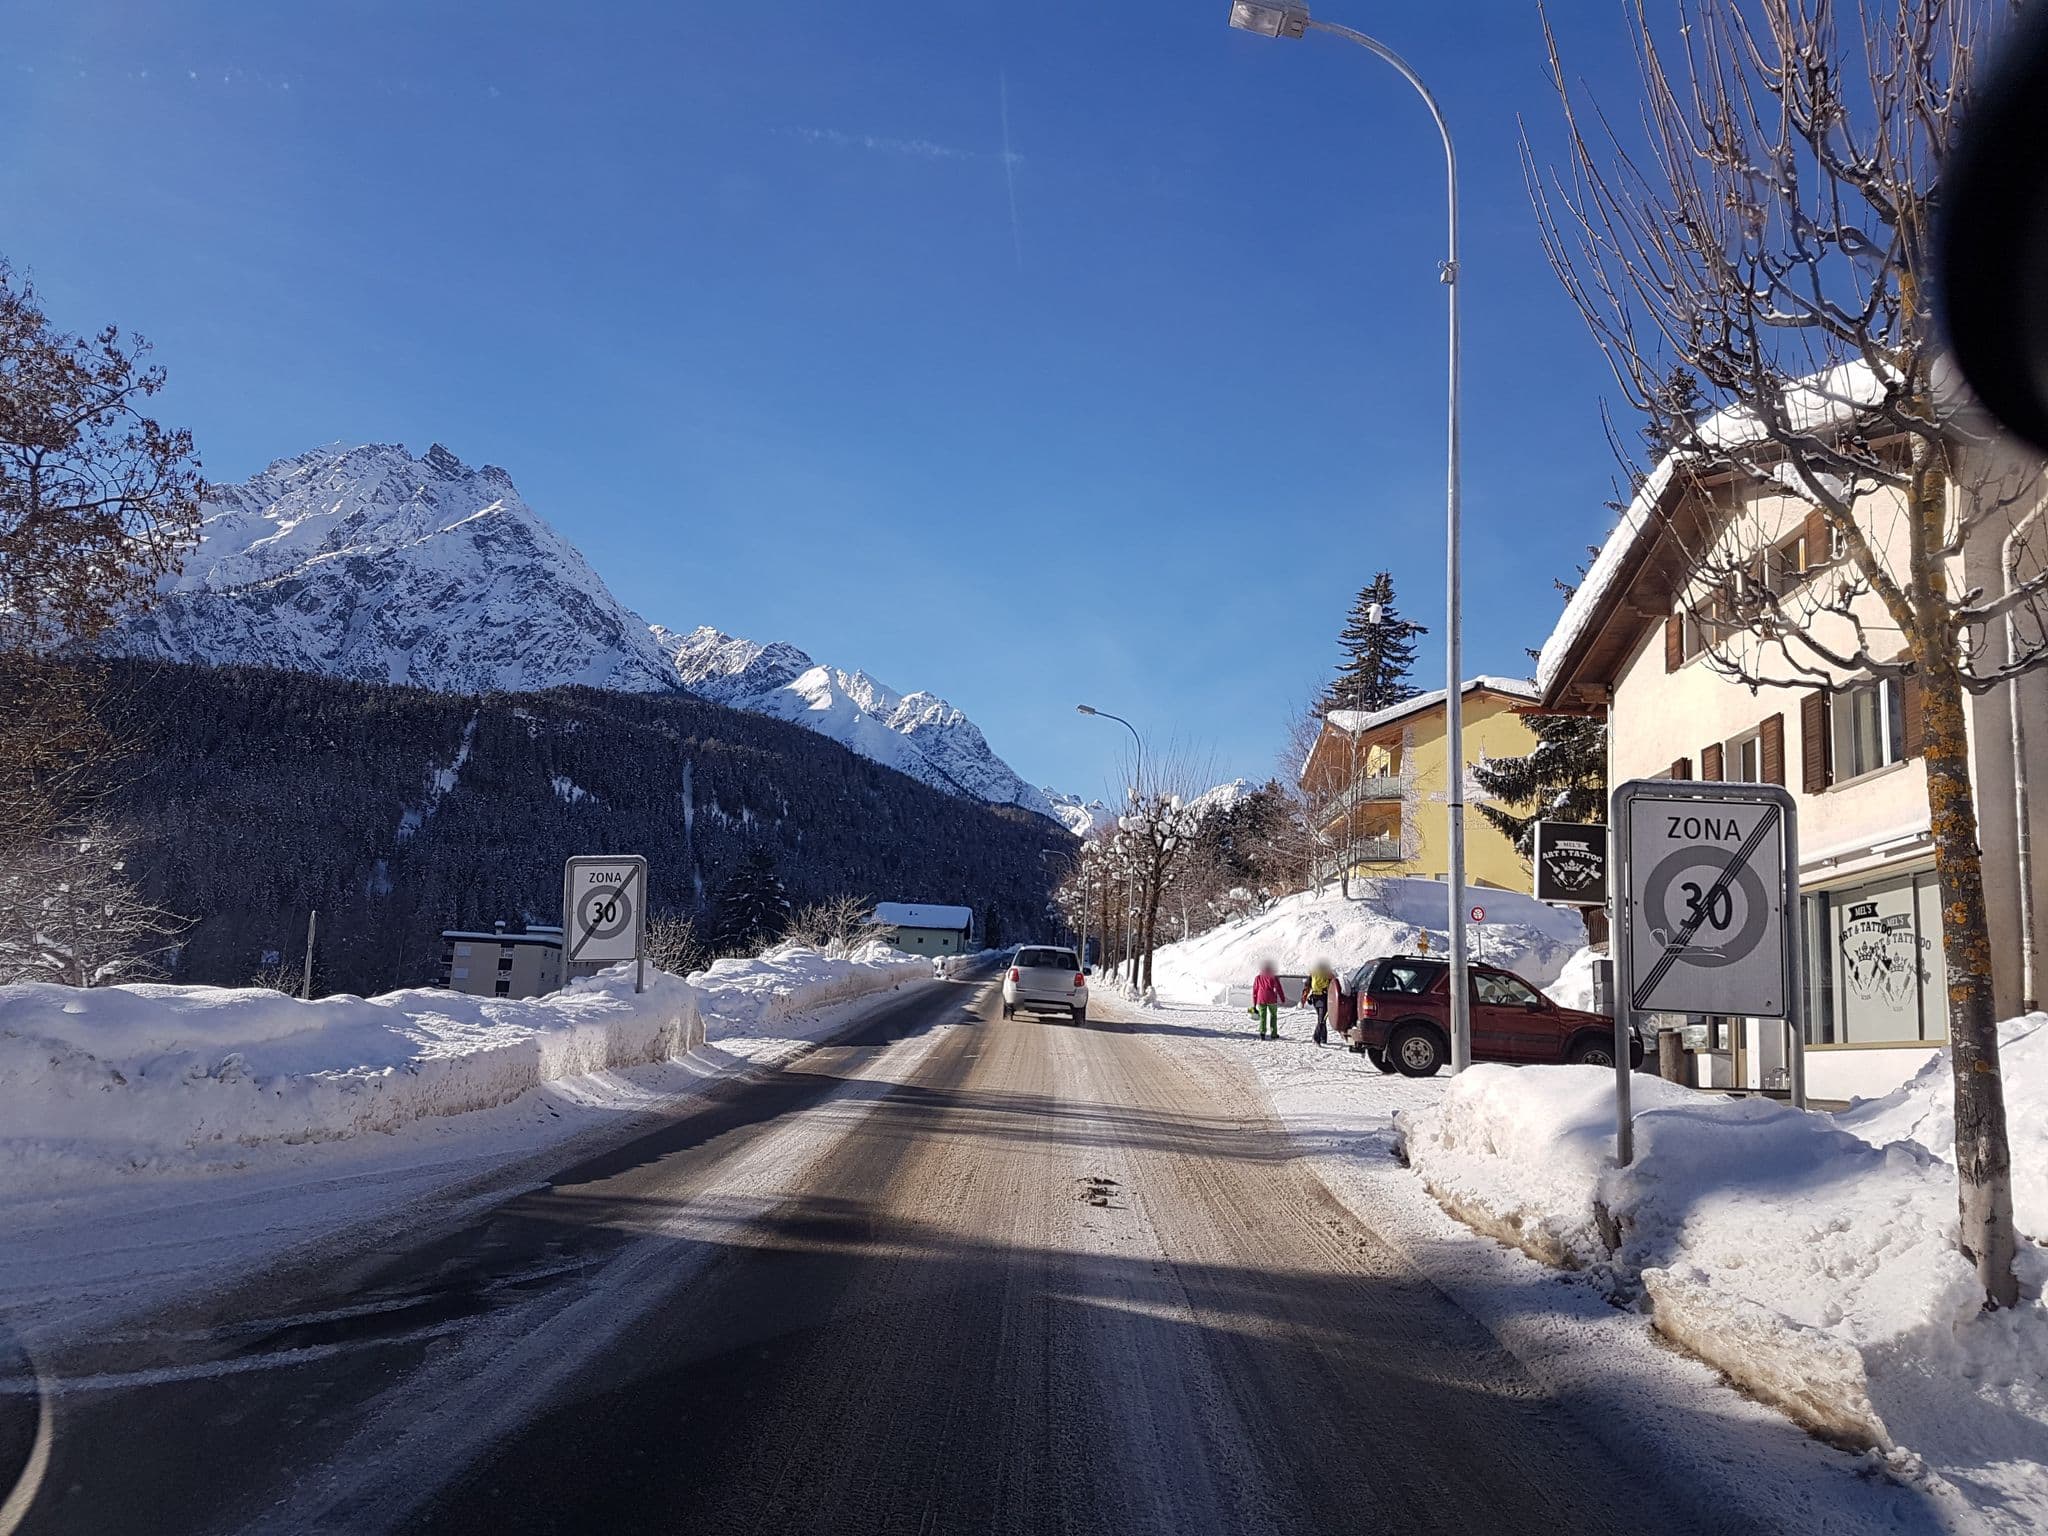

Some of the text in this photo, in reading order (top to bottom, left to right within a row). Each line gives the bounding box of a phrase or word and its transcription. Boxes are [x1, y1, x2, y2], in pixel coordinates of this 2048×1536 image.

[1667, 816, 1742, 841] ZONA
[1542, 850, 1560, 860] ART
[1568, 850, 1603, 863] TATTOO
[589, 872, 622, 883] ZONA
[592, 902, 616, 923] 30
[1680, 882, 1733, 931] 30
[1855, 904, 1872, 916] MEL'S
[1839, 921, 1892, 944] ART & TATTOO
